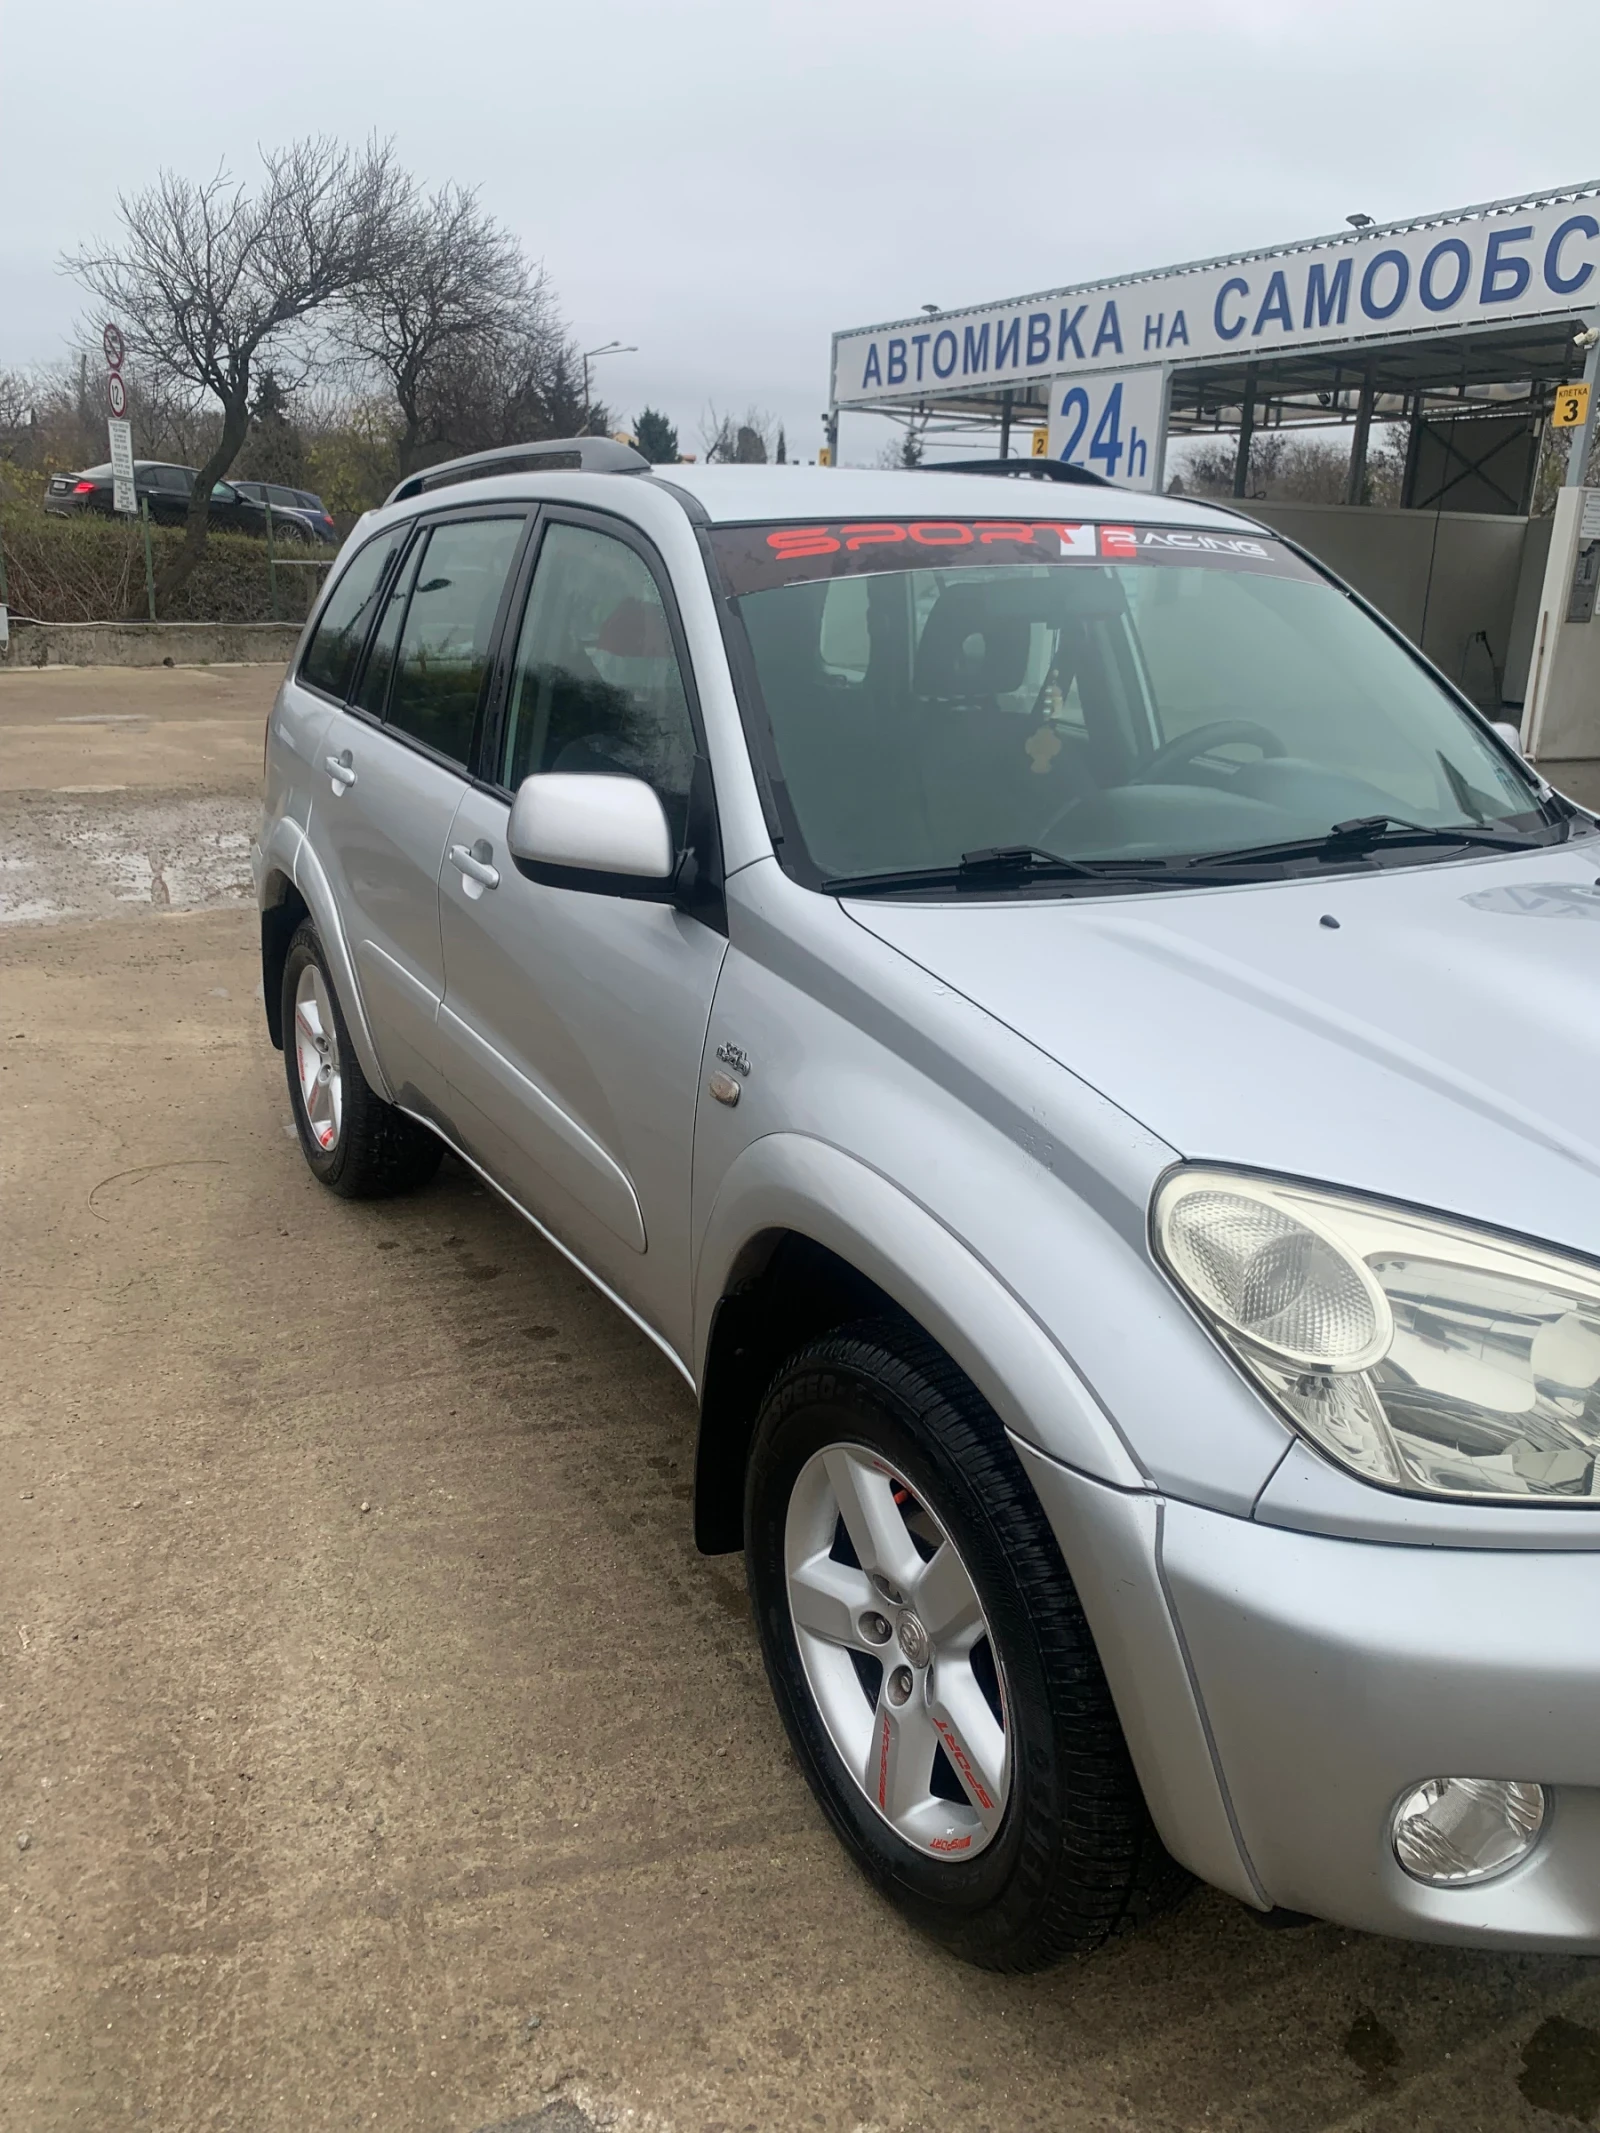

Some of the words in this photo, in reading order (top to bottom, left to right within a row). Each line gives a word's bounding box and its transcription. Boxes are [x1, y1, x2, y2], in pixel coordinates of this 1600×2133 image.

[862, 300, 1123, 389] АВТОМИВКА
[1213, 214, 1600, 341] САМООБС
[1563, 399, 1579, 422] 3
[1036, 438, 1045, 455] 2
[766, 521, 1083, 560] SPORT
[1103, 530, 1268, 557] RACING
[932, 1717, 995, 1810] SPORT
